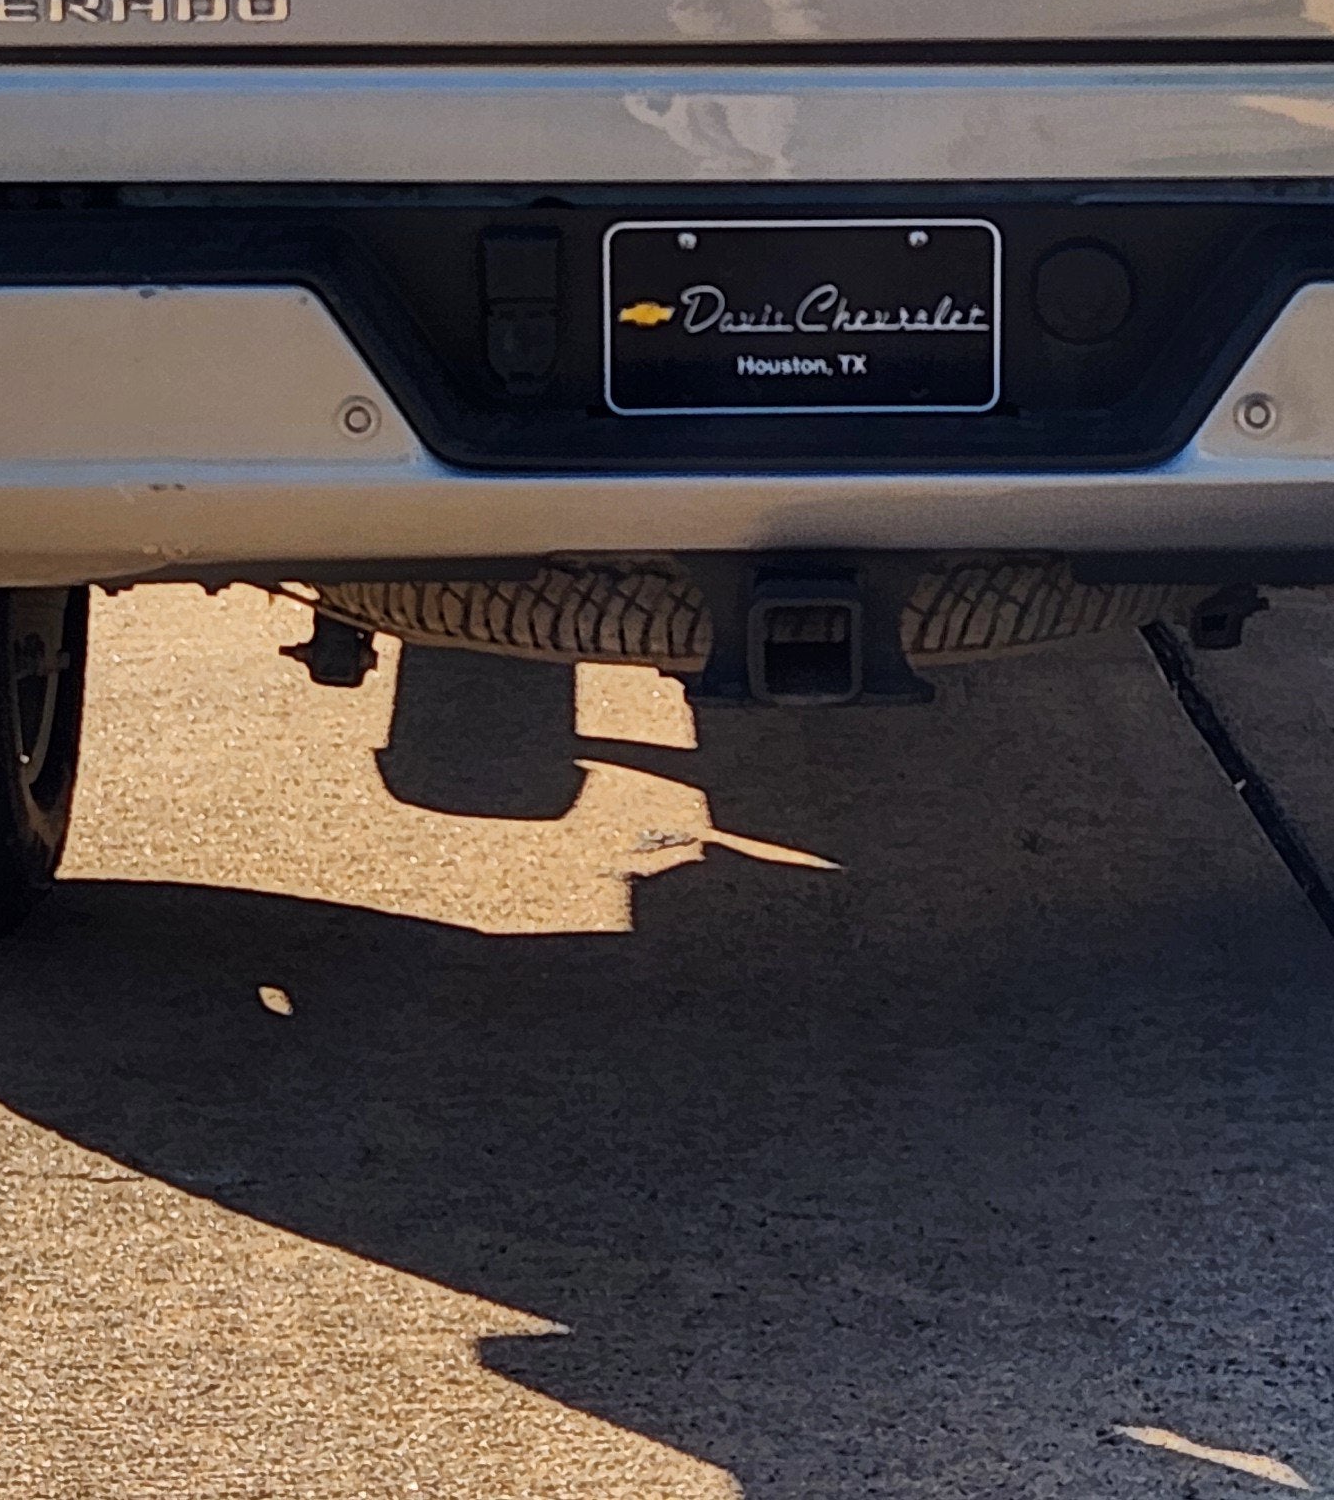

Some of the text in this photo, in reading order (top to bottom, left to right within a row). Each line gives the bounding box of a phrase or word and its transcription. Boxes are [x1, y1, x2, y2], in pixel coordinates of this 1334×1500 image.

[679, 283, 990, 334] Davis Chevrolet
[737, 354, 869, 377] Houston, TX
